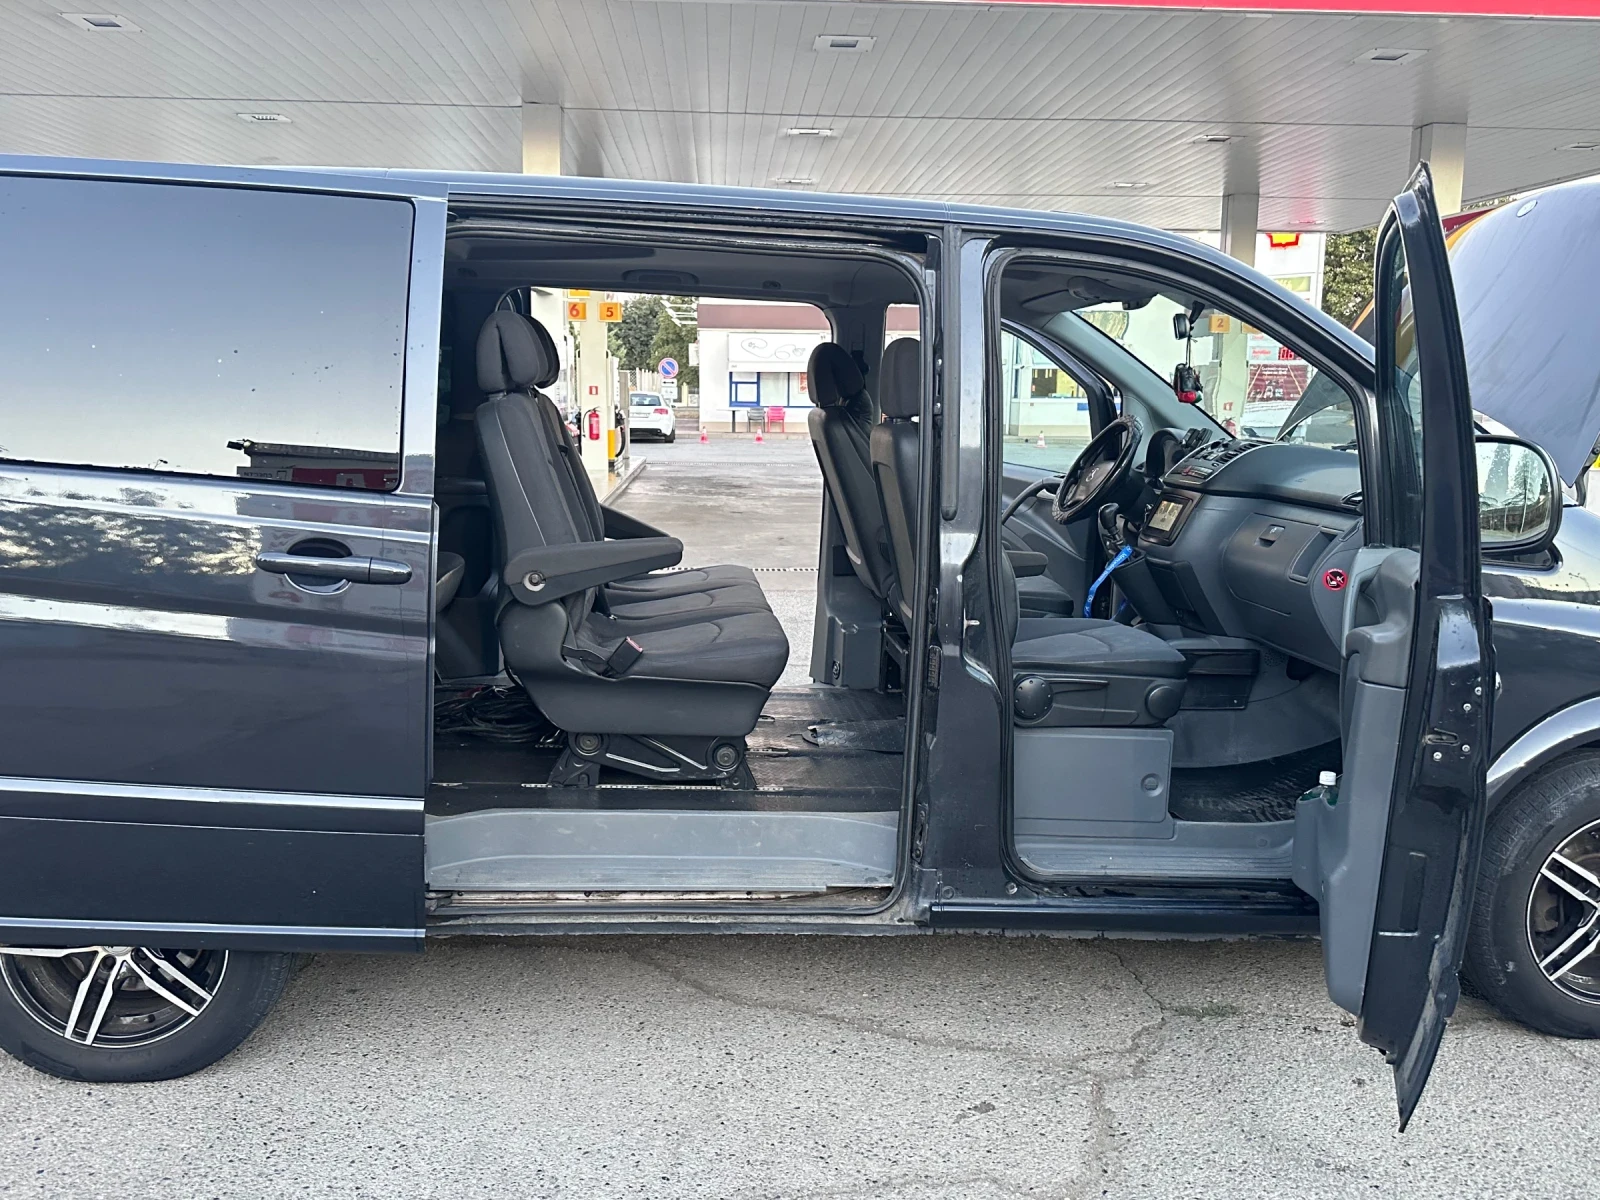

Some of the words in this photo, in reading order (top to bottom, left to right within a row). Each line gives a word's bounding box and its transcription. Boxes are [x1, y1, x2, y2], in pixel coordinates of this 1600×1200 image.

[569, 303, 580, 318] 6
[606, 306, 614, 318] 5
[1217, 317, 1224, 328] 2
